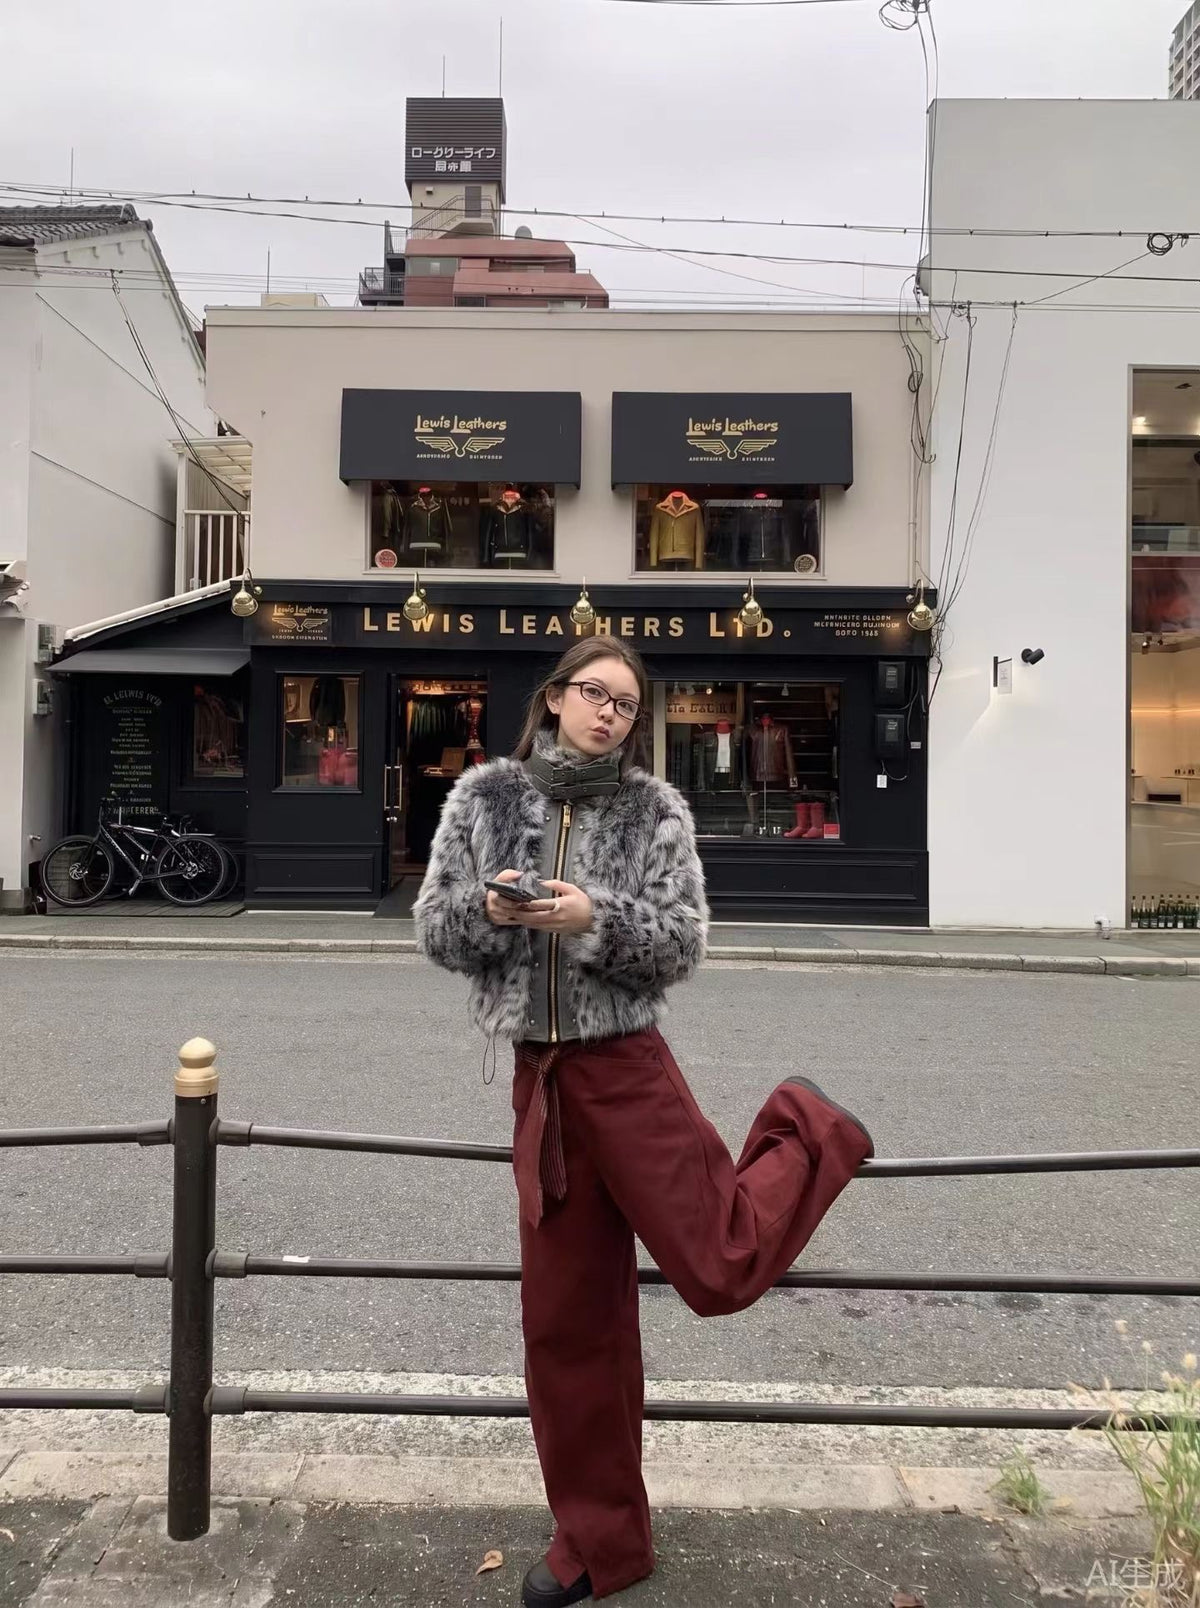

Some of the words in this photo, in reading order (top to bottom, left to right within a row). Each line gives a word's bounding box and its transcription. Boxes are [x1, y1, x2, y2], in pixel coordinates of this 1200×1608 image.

[414, 414, 451, 433] Lewis
[450, 415, 507, 433] Leathers
[686, 417, 722, 435] Lewis
[722, 417, 779, 436] Leathers
